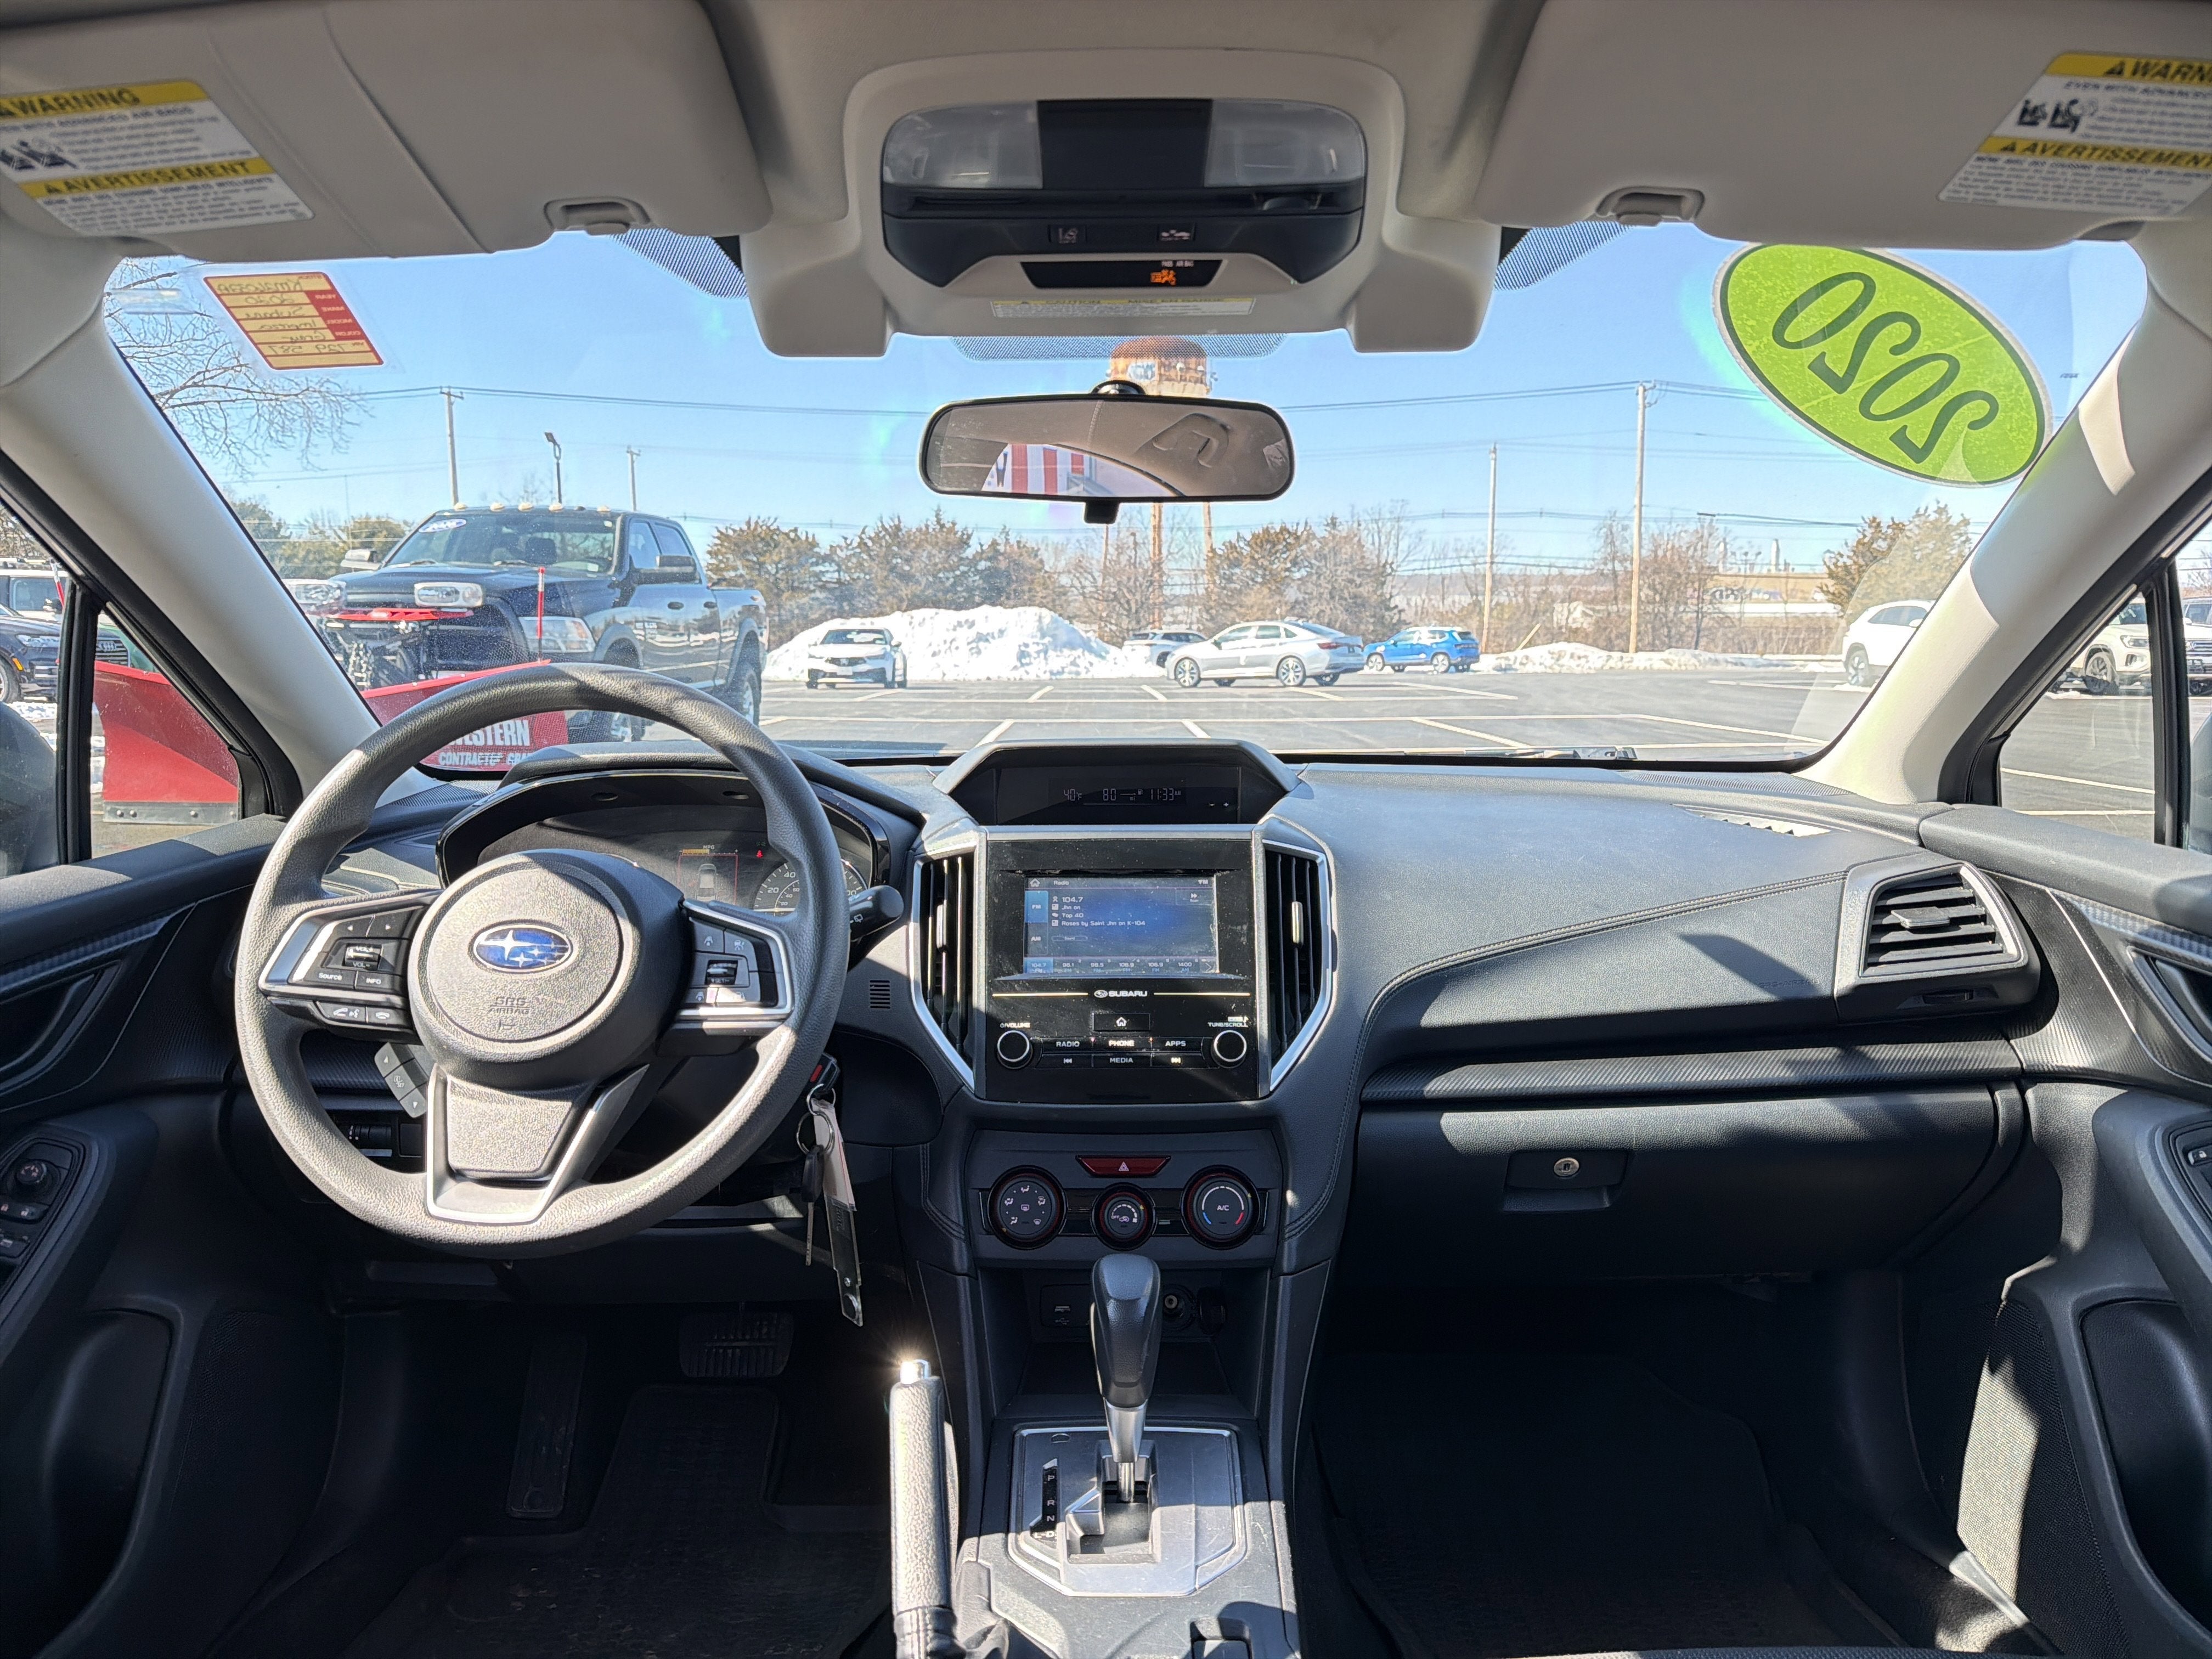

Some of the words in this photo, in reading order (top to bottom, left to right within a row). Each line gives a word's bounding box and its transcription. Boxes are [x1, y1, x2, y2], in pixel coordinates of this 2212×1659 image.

[11, 88, 141, 115] WARNING
[1103, 788, 1116, 801] 80
[1151, 788, 1174, 801] 11:33
[495, 996, 528, 1006] SRS
